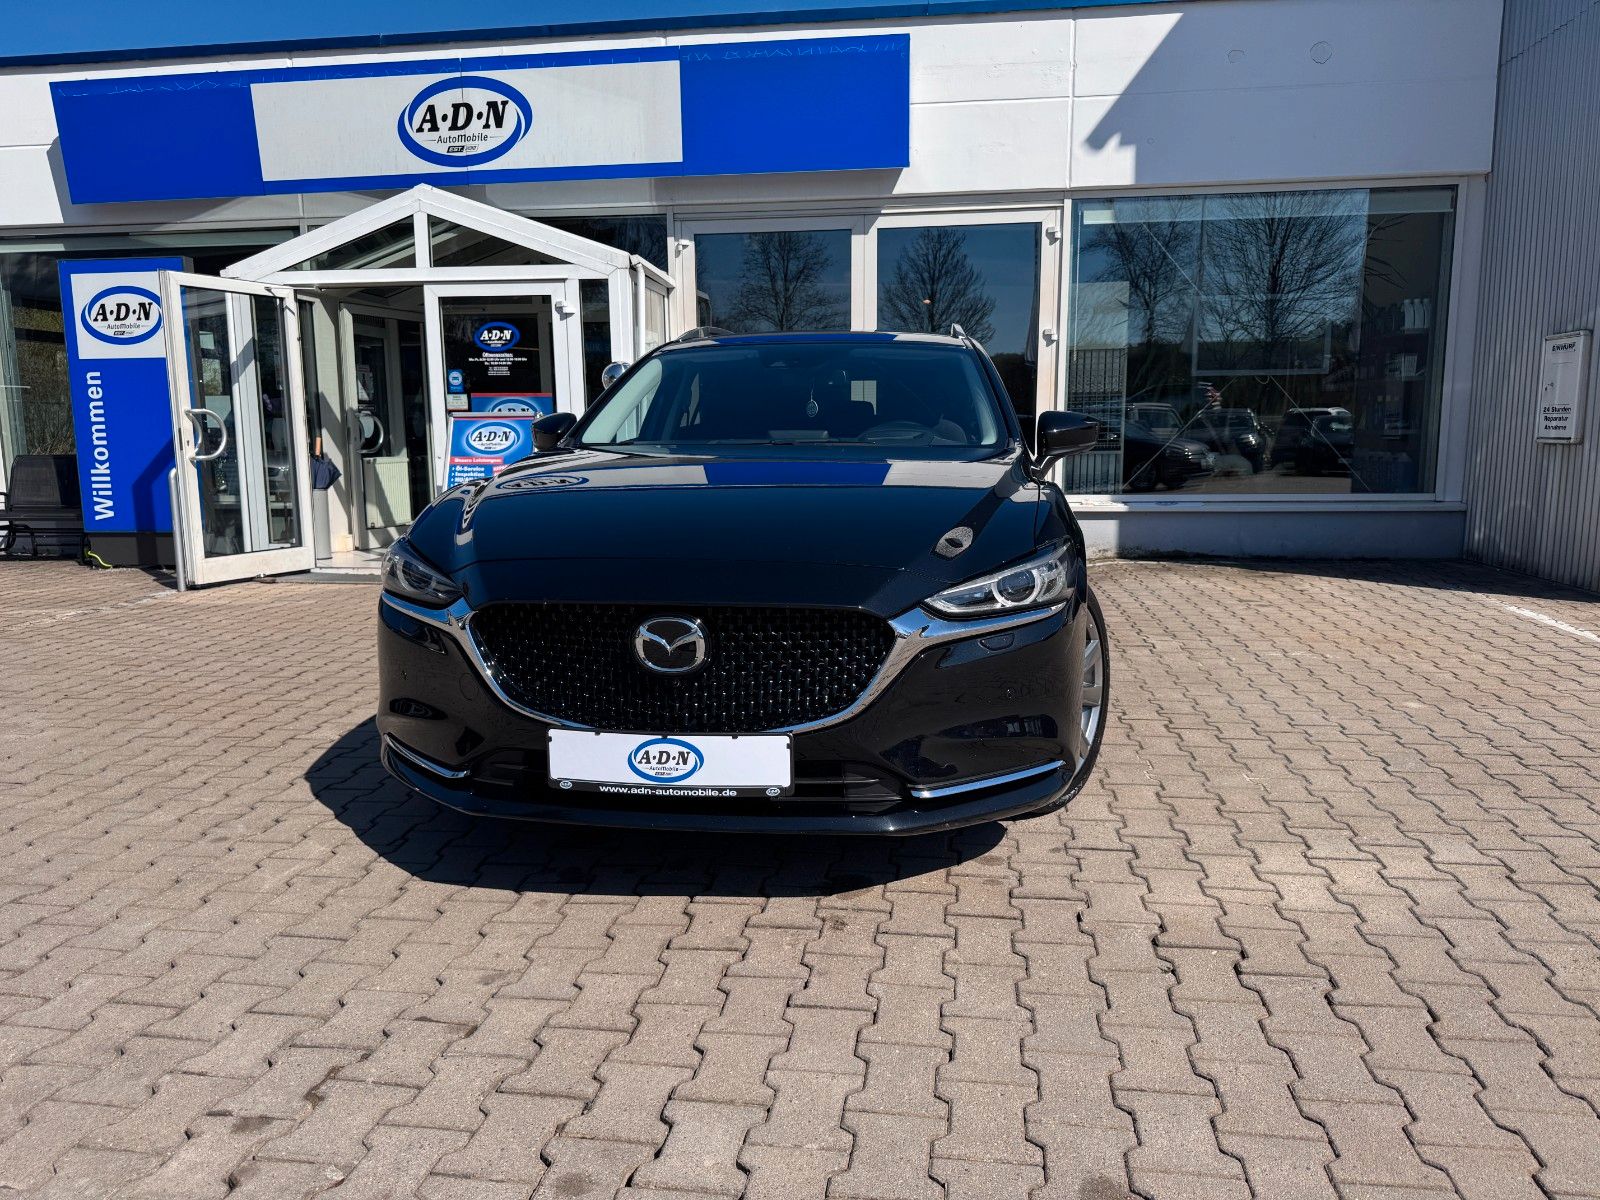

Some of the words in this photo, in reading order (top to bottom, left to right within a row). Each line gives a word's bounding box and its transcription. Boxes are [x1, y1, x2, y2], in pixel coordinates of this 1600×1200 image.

[437, 133, 489, 144] AutoMobile
[86, 371, 115, 521] Willkommen
[599, 785, 737, 797] www.adn-automobile.de
